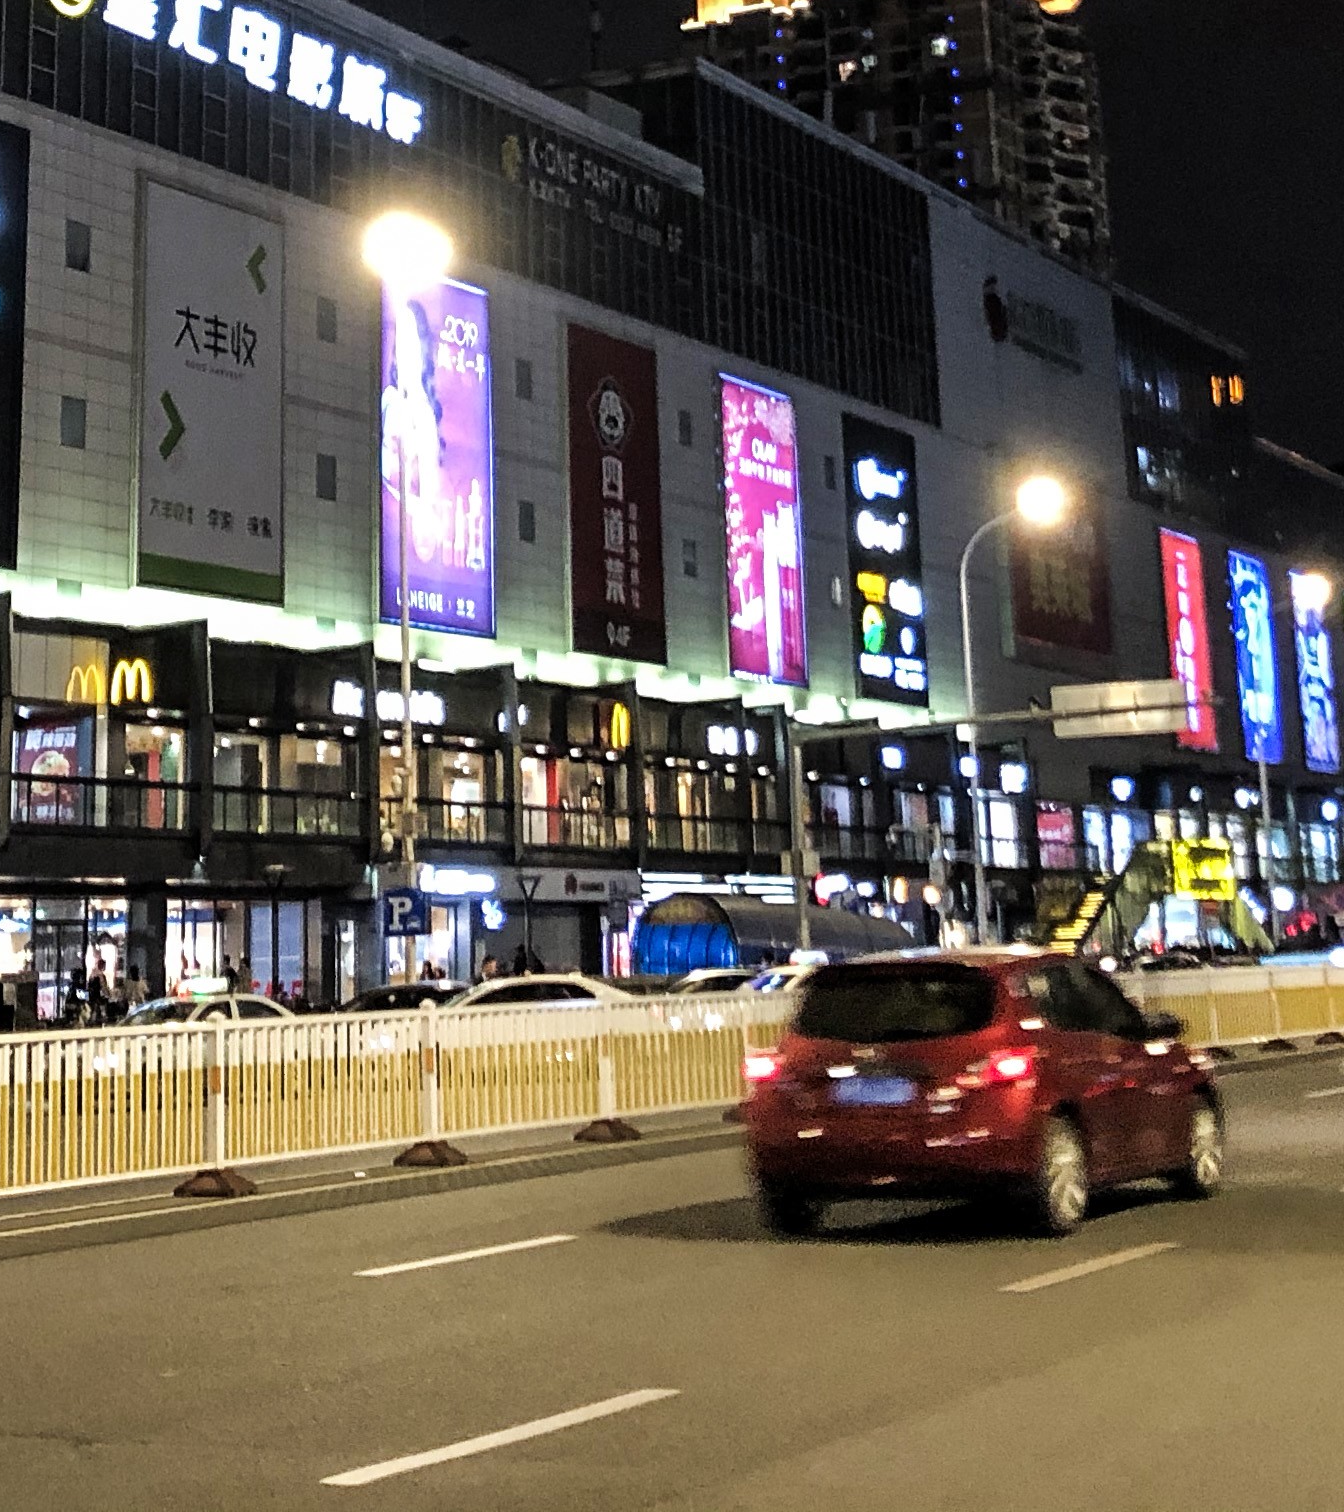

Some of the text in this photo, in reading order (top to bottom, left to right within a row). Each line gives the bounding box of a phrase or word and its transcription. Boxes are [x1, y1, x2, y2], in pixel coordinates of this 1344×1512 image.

[174, 305, 257, 368] 大丰收
[439, 314, 479, 348] 2019
[396, 586, 443, 613] LNEIGE
[388, 895, 413, 931] P
